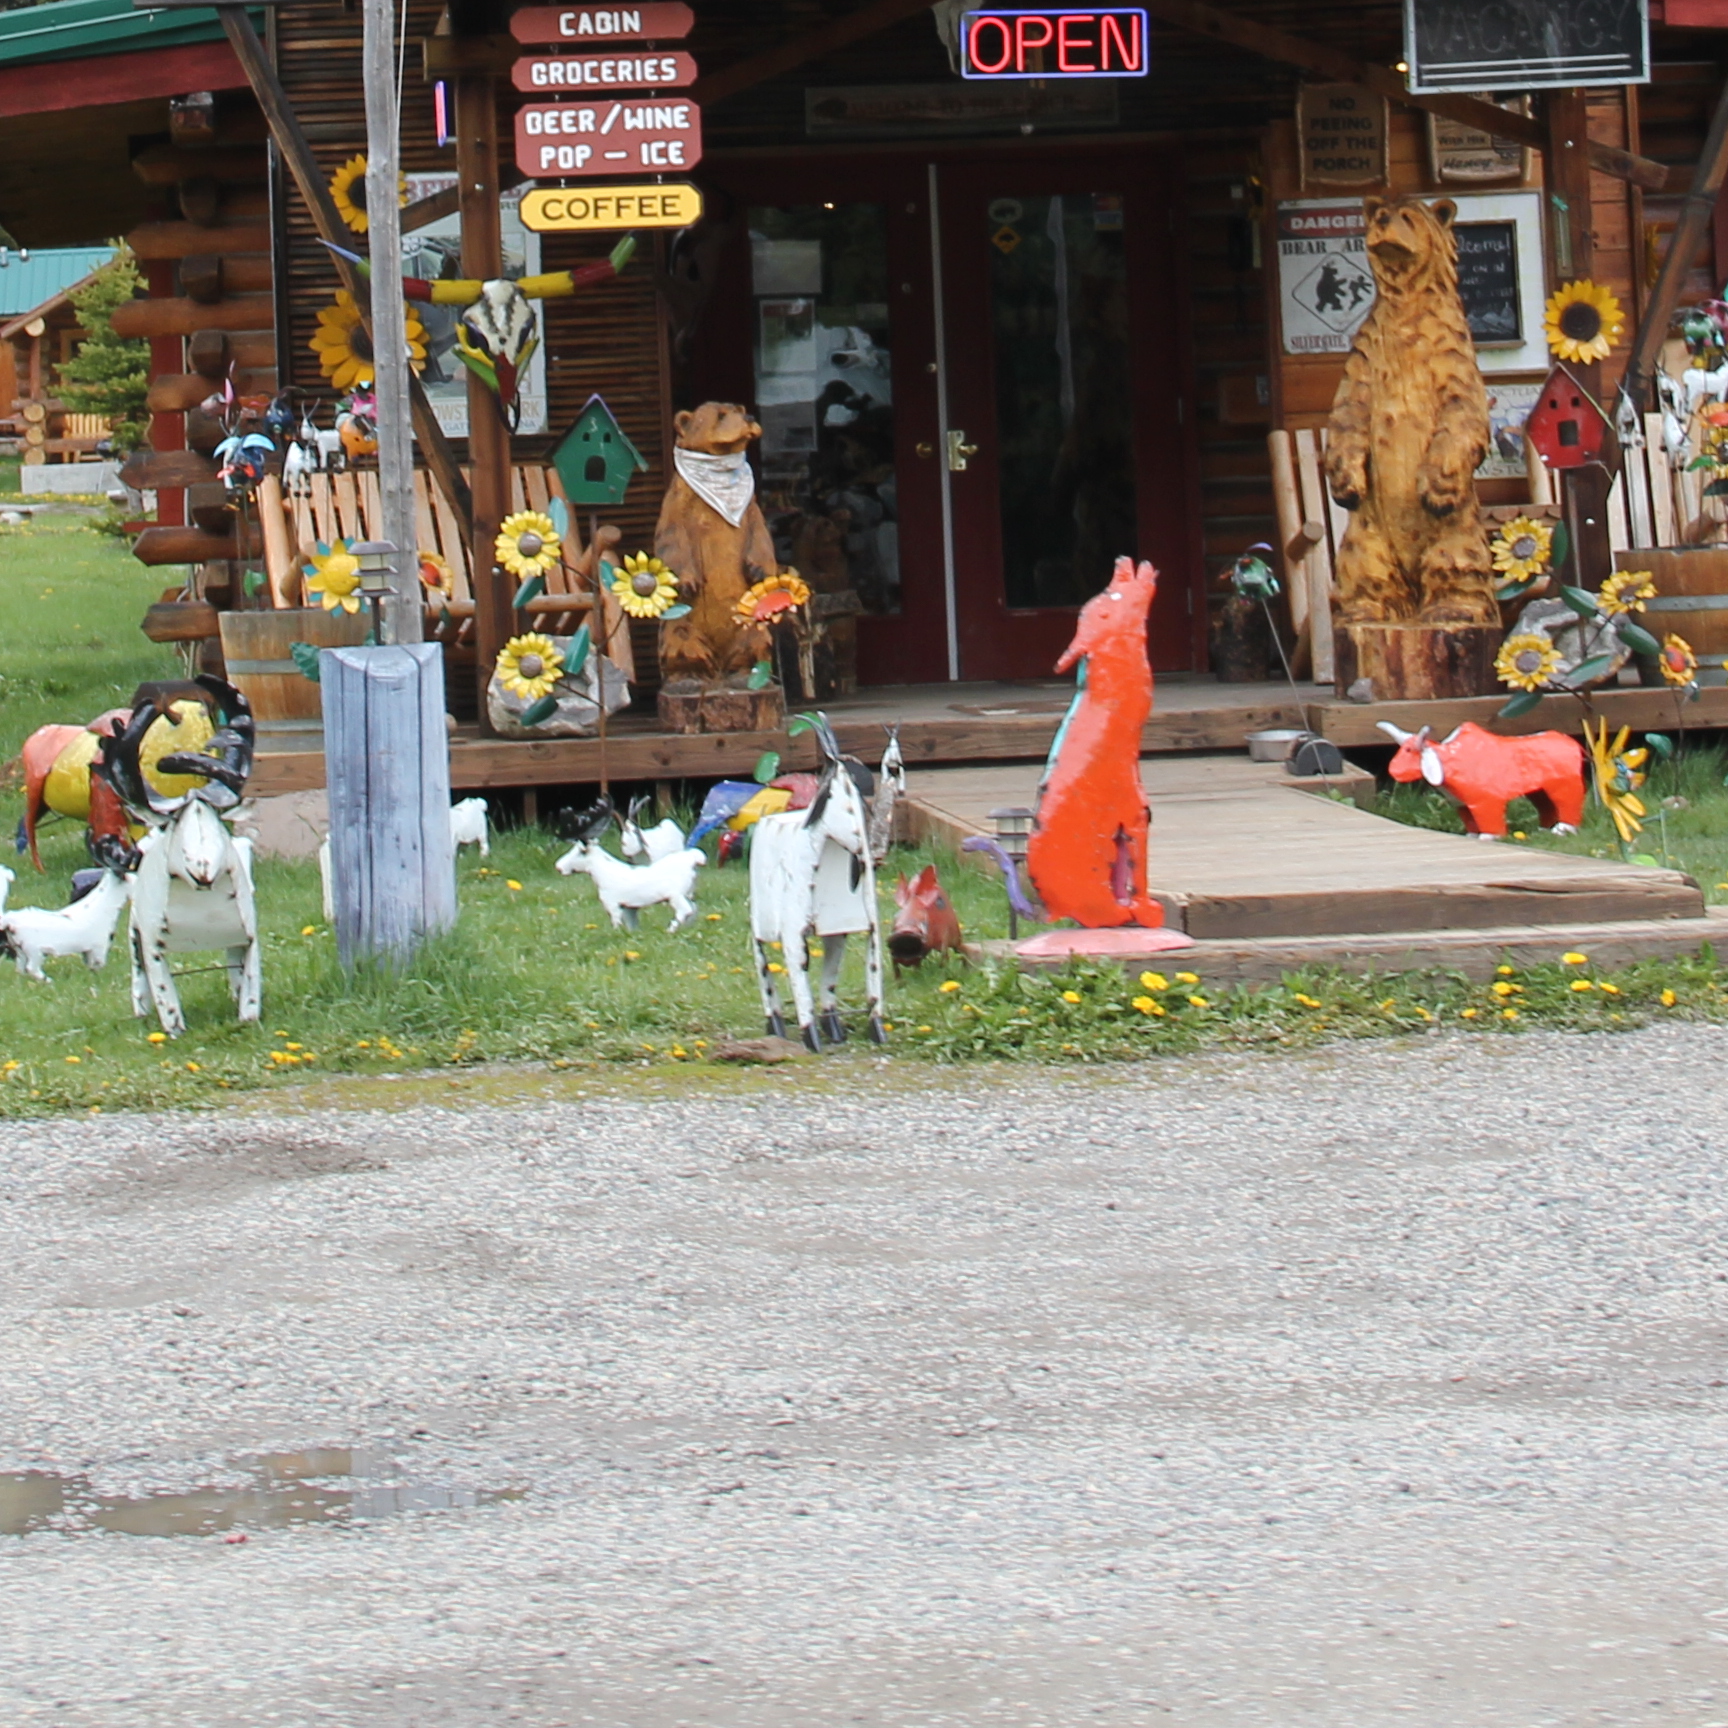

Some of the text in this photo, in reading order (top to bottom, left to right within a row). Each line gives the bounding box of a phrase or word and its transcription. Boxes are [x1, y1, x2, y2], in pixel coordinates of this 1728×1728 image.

[559, 10, 641, 36] CABIN
[969, 14, 1140, 74] OPEN
[531, 57, 678, 86] GROCERIES
[540, 144, 592, 170] POP
[640, 140, 685, 165] ICE
[1306, 136, 1377, 150] OFF THE
[1313, 158, 1370, 171] PORCH
[541, 194, 682, 221] COFFEE
[1281, 238, 1365, 255] BEAR AR
